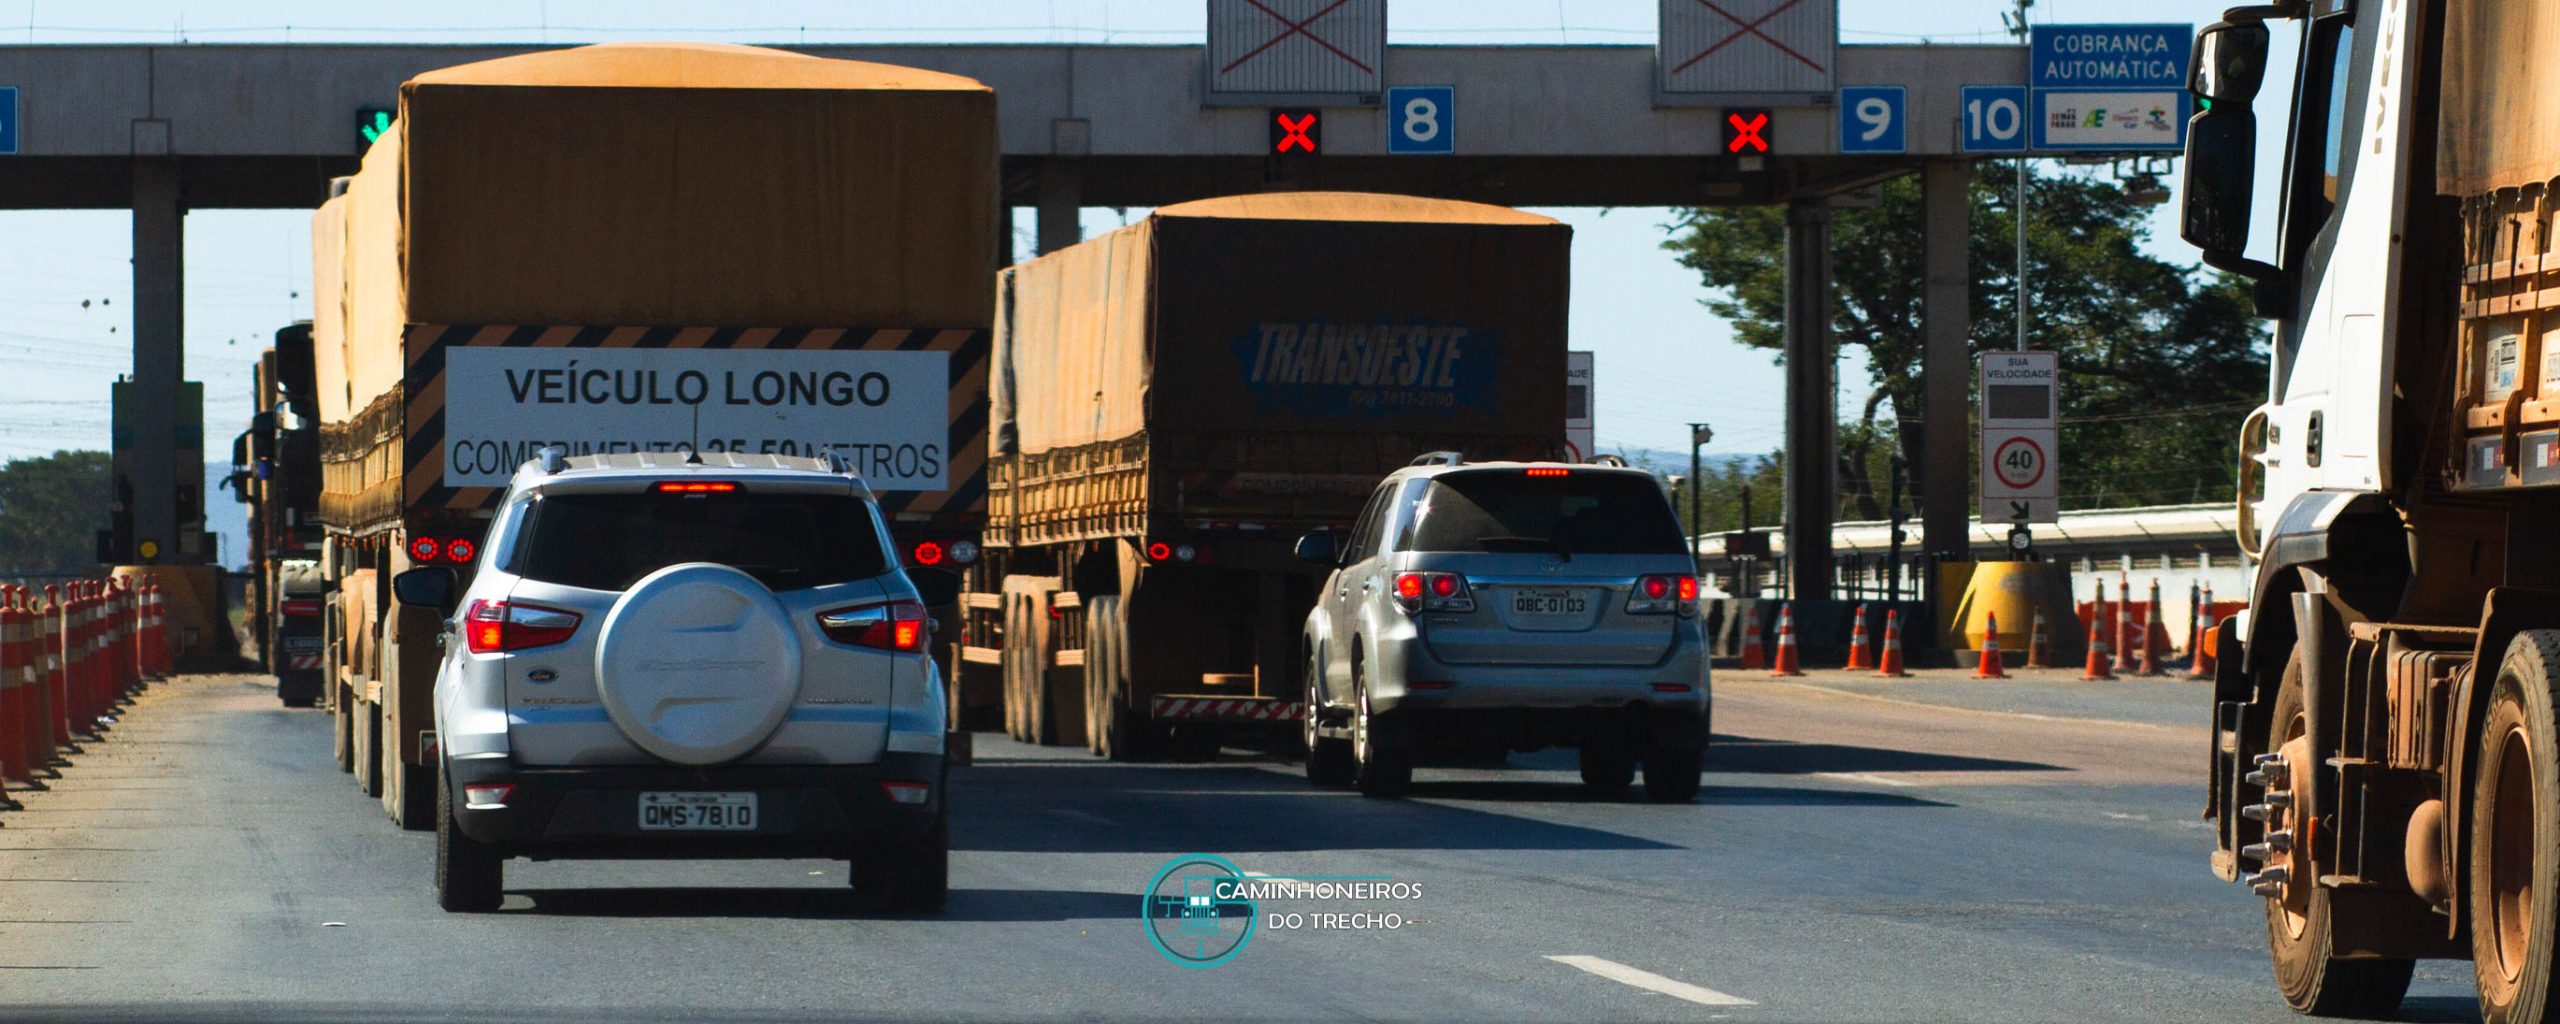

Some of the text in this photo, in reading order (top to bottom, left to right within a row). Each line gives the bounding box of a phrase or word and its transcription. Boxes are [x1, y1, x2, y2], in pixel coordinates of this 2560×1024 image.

[2053, 34, 2169, 56] COBRANÇA
[2045, 54, 2178, 79] AUTOMÁTICA
[1403, 97, 1438, 142] 8
[1856, 97, 1892, 142] 9
[1968, 98, 2021, 140] 10
[1250, 321, 1468, 388] TRANSOESTE
[2007, 357, 2029, 366] SUA
[505, 360, 890, 407] VEÍCULO LONGO
[1987, 369, 2052, 379] VELOCIDADE
[2006, 450, 2032, 469] 40
[1516, 598, 1585, 612] QBC-0103
